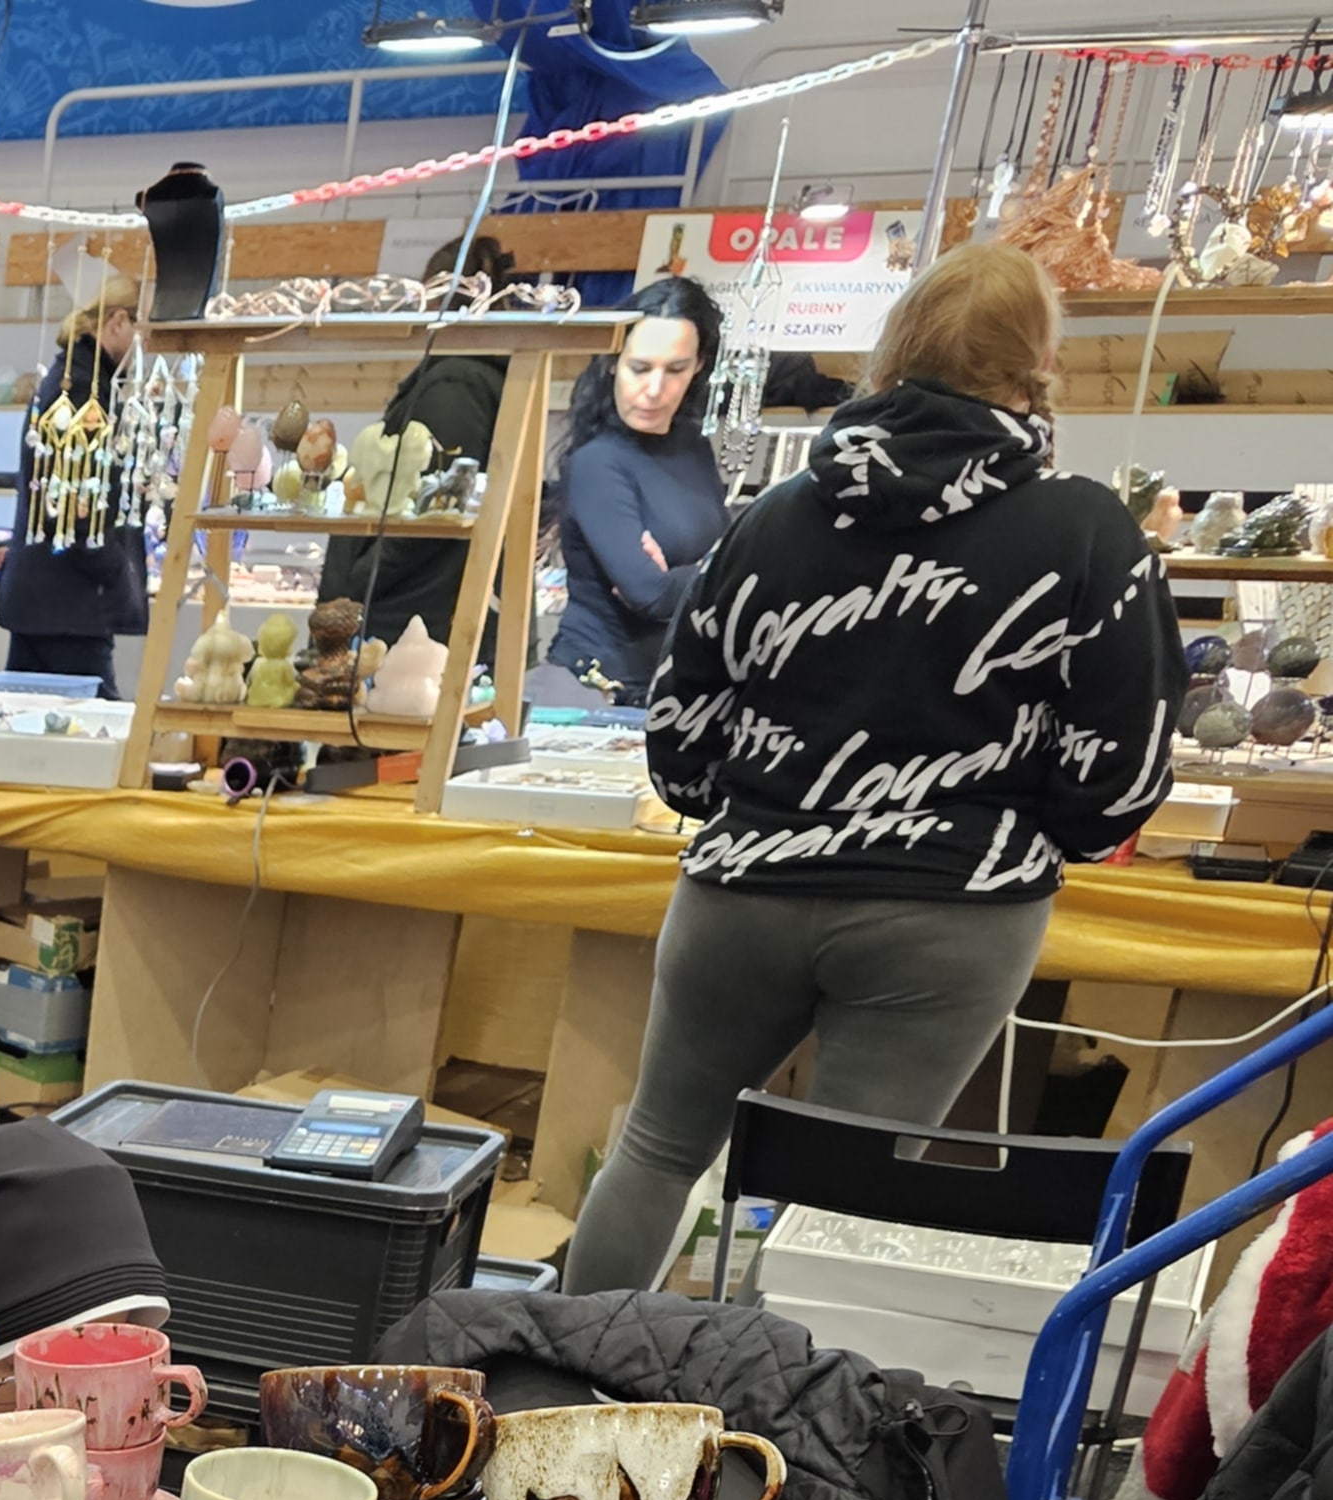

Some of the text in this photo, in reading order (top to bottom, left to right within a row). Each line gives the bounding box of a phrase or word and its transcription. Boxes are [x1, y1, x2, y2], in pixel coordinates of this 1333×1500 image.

[730, 226, 845, 251] OPALE
[792, 280, 908, 295] AKWAMARYNY
[786, 302, 846, 316] RUBINY
[783, 323, 847, 336] SZAFIRY
